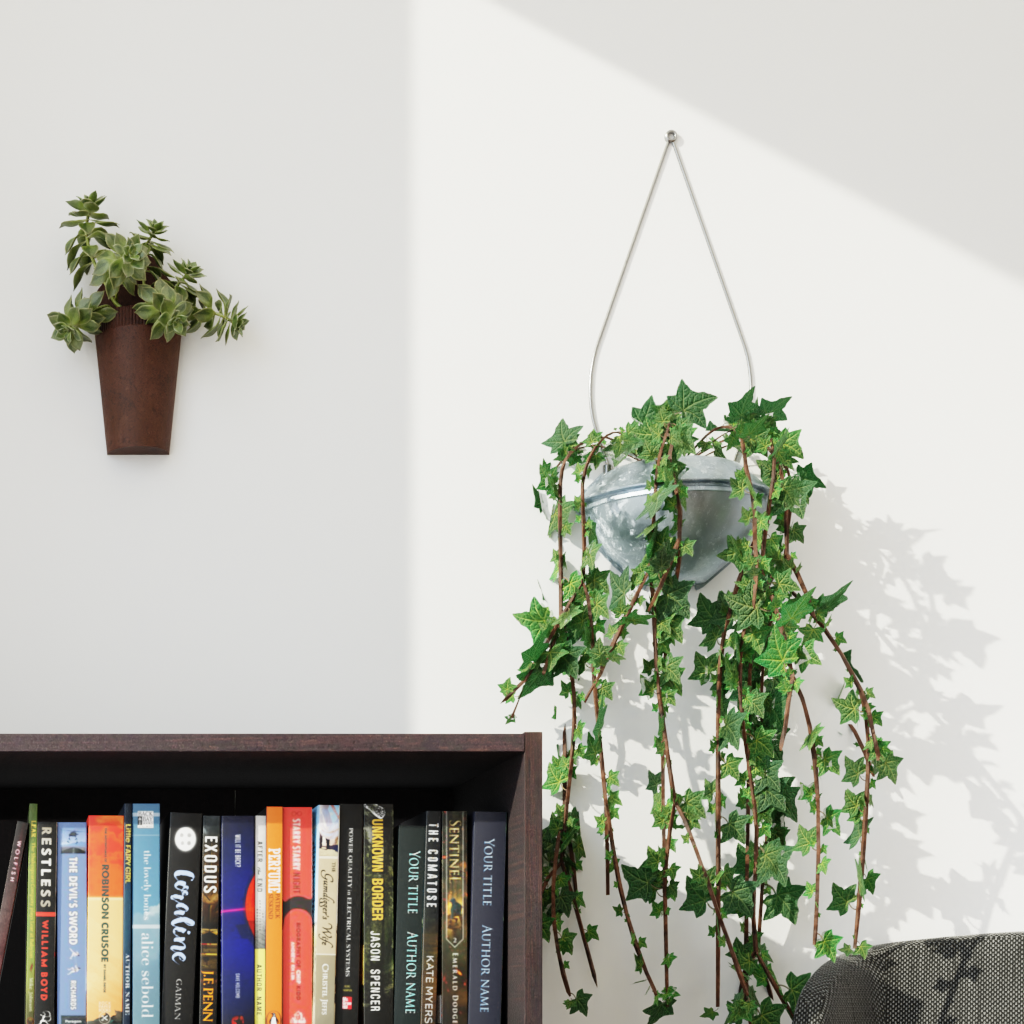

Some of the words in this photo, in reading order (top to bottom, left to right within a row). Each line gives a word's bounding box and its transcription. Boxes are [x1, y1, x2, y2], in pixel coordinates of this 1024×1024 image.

[292, 818, 301, 844] STARRY
[371, 818, 384, 872] UNKNOWN
[427, 823, 439, 843] THE
[9, 840, 22, 883] WOLFISH
[40, 826, 53, 908] RESTLESS
[68, 857, 79, 874] THE
[143, 850, 152, 865] the
[203, 835, 218, 894] EXODUS
[292, 846, 301, 871] STARRY
[407, 850, 421, 882] YOUR
[448, 819, 462, 884] SENTINEL
[141, 866, 152, 890] lovely
[267, 847, 281, 894] PERFUME
[292, 872, 301, 893] NIGHT
[426, 849, 439, 908] COMATOSE
[68, 875, 79, 908] DEVIL'S
[101, 864, 110, 920] ROBINSON
[142, 891, 152, 921] bones
[371, 878, 384, 921] BORDER
[407, 884, 418, 914] TITLE
[68, 911, 78, 945] SWORD
[170, 869, 196, 965] Coraline
[40, 919, 50, 968] WILLIAM
[101, 922, 109, 963] CRUSOE
[141, 932, 154, 965] alice
[370, 930, 381, 962] JASON
[405, 931, 418, 979] AUTHOR
[481, 924, 493, 976] AUTHOR
[40, 971, 49, 1001] BOYD
[201, 970, 215, 985] J.F.
[425, 955, 434, 983] KATE
[140, 970, 154, 1018] sebold
[174, 978, 183, 1020] GAIMAN
[202, 987, 214, 1022] PENN
[370, 969, 381, 1012] SPENCER
[405, 982, 416, 1014] NAME
[424, 986, 434, 1024] MYERS
[479, 979, 490, 1012] NAME
